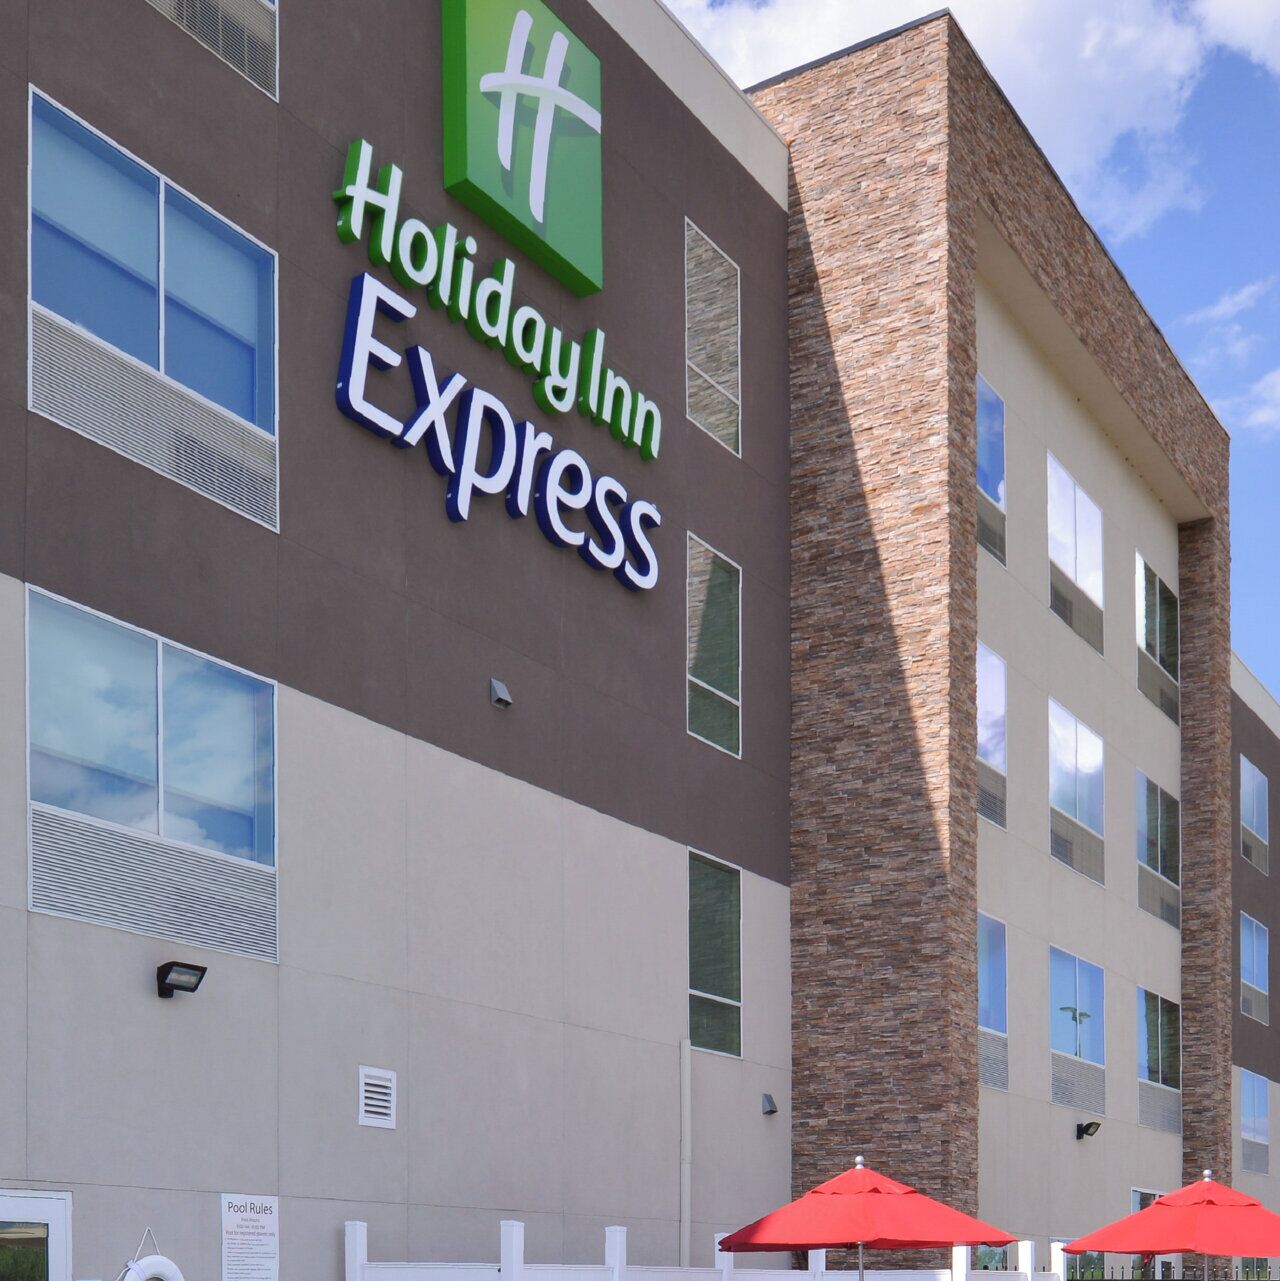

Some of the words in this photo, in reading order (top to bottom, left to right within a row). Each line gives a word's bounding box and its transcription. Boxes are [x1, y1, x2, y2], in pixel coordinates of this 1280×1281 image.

[333, 138, 581, 415] Holiday
[579, 328, 662, 460] Inn
[336, 272, 661, 592] Express
[227, 1201, 248, 1213] Pool
[249, 1202, 273, 1215] Rules
